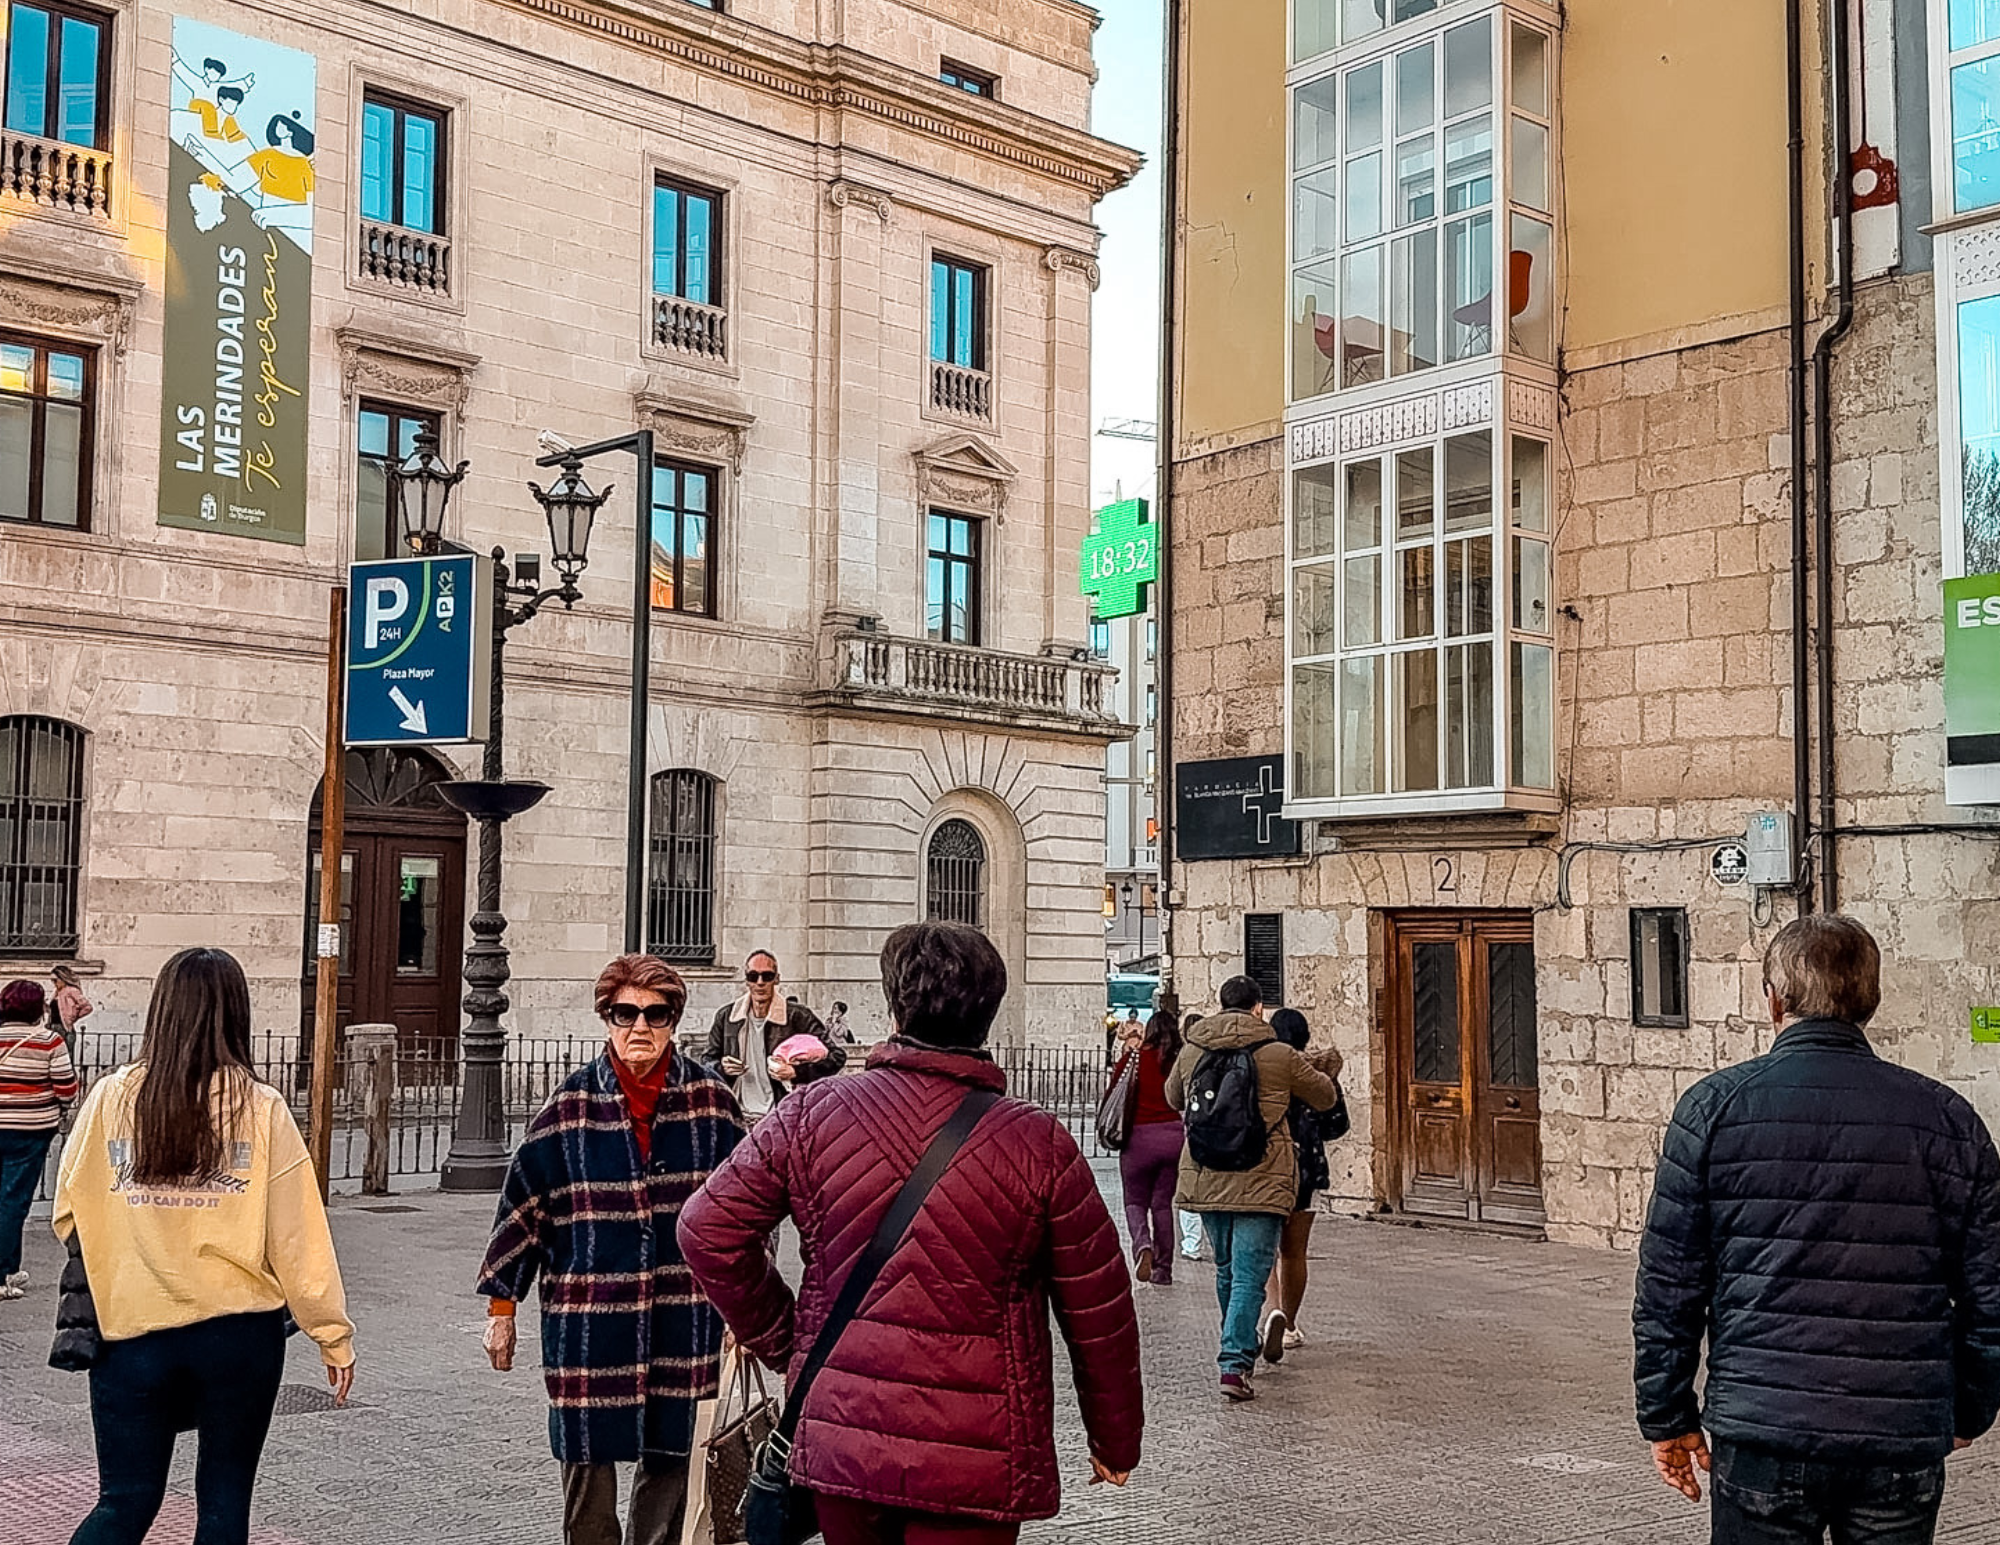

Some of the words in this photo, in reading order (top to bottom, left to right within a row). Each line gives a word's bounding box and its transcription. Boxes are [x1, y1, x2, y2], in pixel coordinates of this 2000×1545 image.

[254, 232, 302, 428] esperan
[212, 244, 248, 479] MERINDADES
[176, 404, 206, 473] LAS
[244, 440, 281, 493] Te
[1089, 538, 1150, 580] 18:32
[364, 576, 409, 650] P
[379, 626, 402, 641] 24H
[382, 668, 407, 680] Plaza
[408, 666, 435, 681] Mayor
[1433, 857, 1456, 892] 2
[127, 1194, 149, 1206] YOU
[153, 1195, 181, 1207] CAN
[184, 1197, 205, 1207] DO
[207, 1197, 220, 1208] IT
